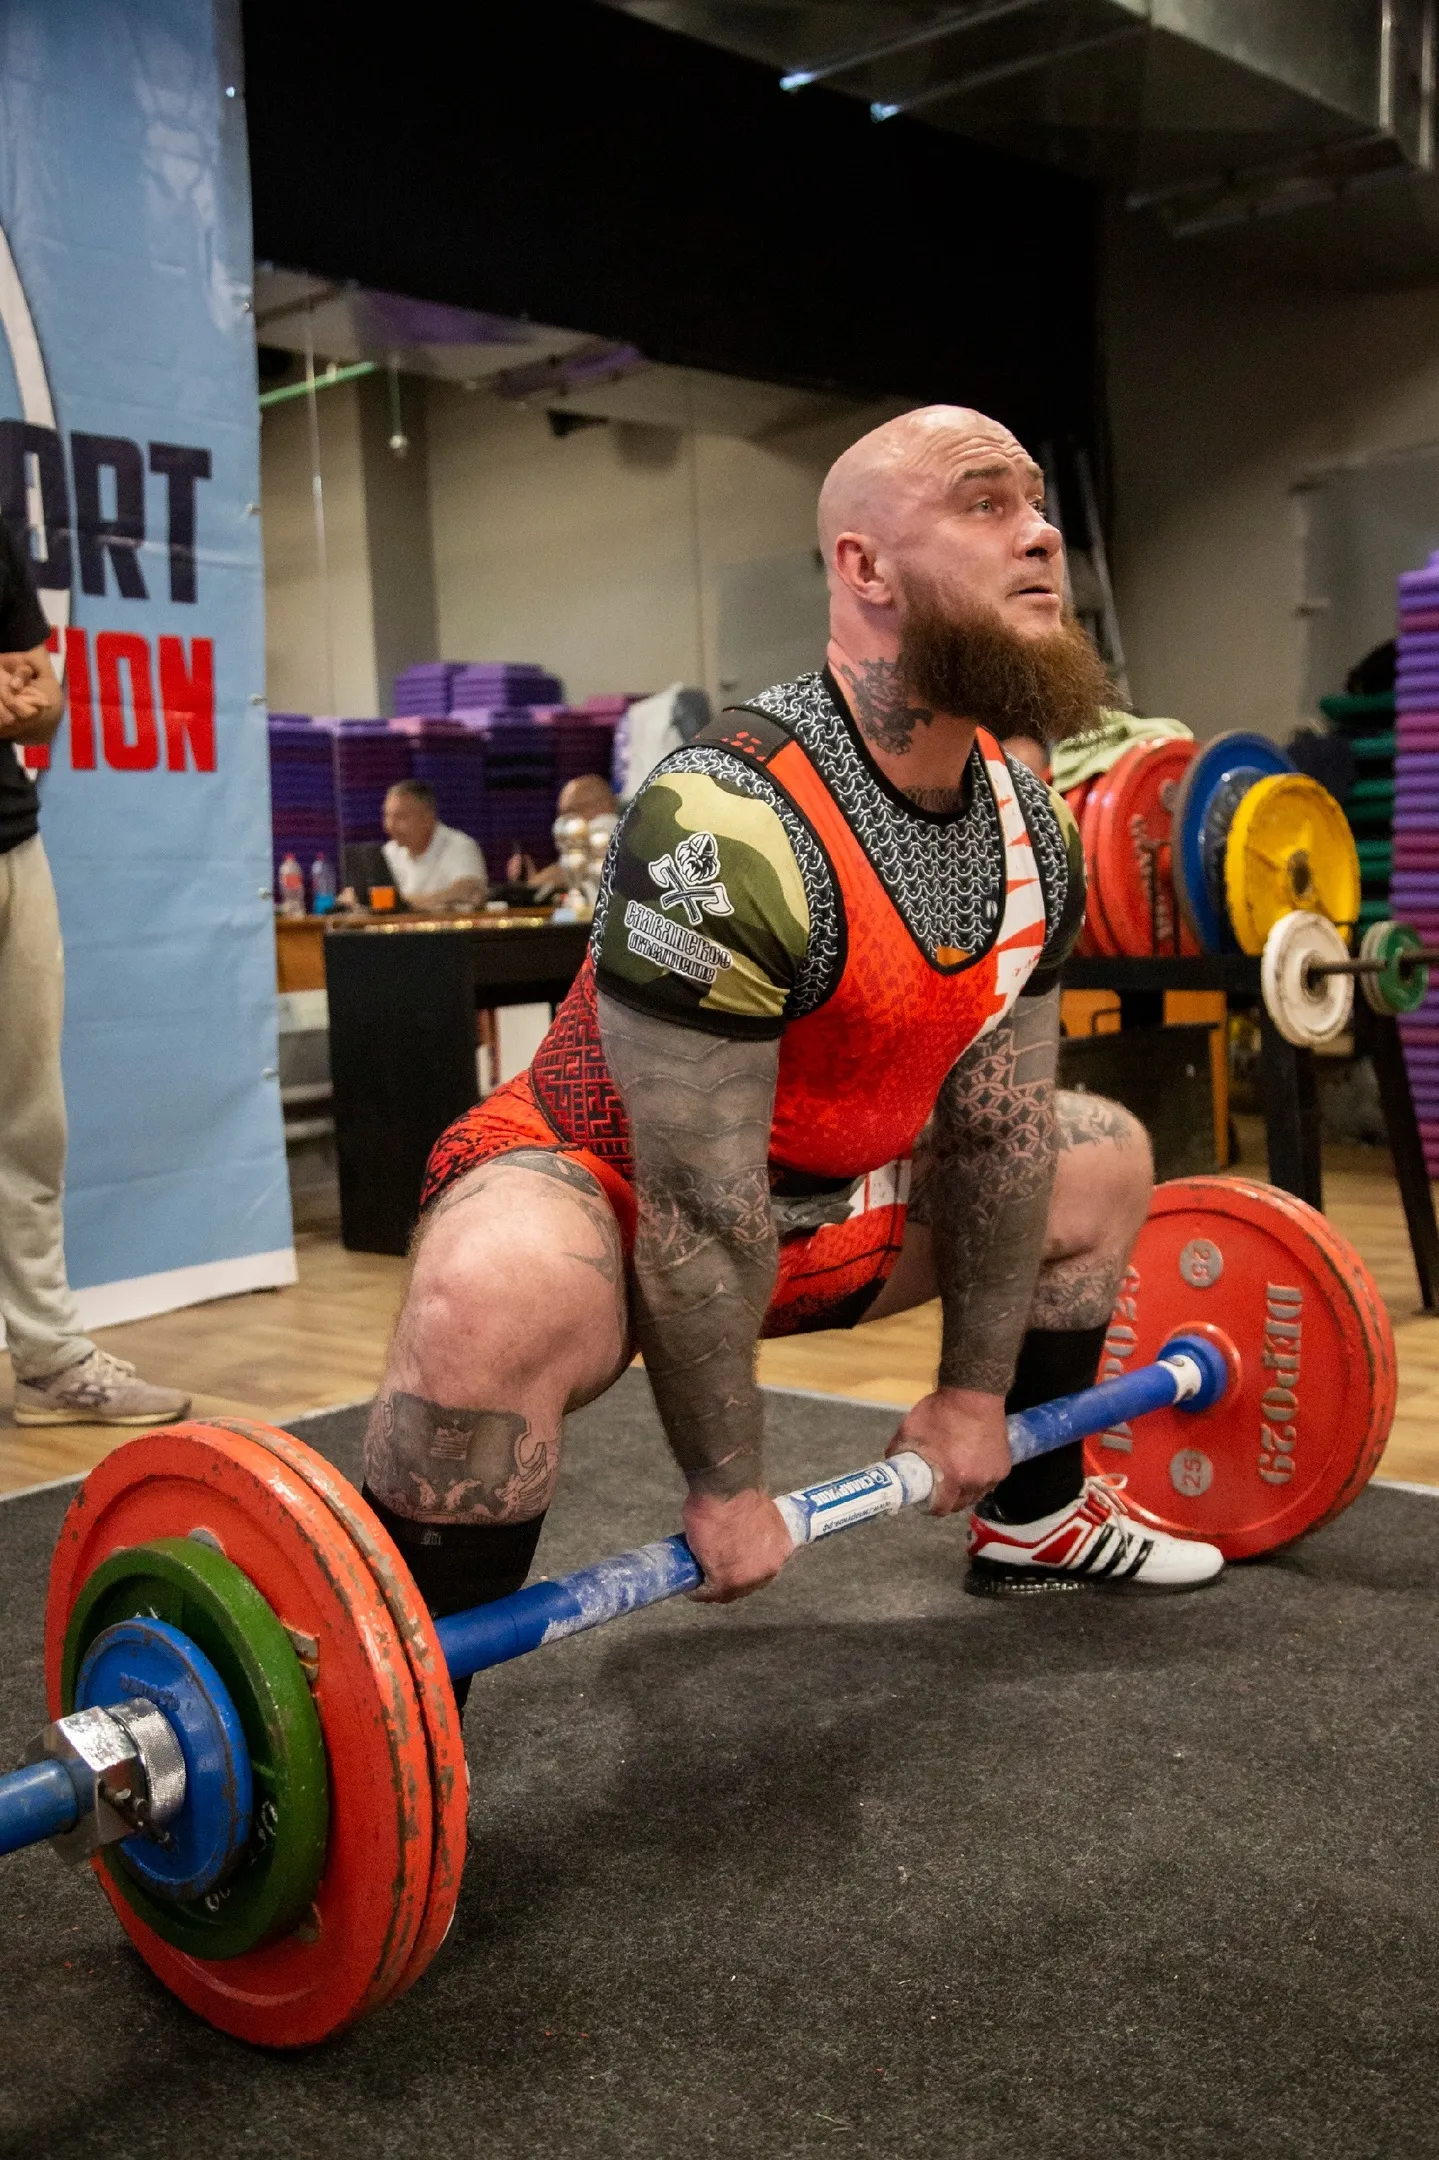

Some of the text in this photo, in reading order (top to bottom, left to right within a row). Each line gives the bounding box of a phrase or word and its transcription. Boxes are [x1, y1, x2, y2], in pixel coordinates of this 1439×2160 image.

[25, 626, 218, 773] ION
[1191, 1247, 1211, 1280] 25
[1258, 1281, 1303, 1486] DEPO29
[1182, 1457, 1202, 1489] 25
